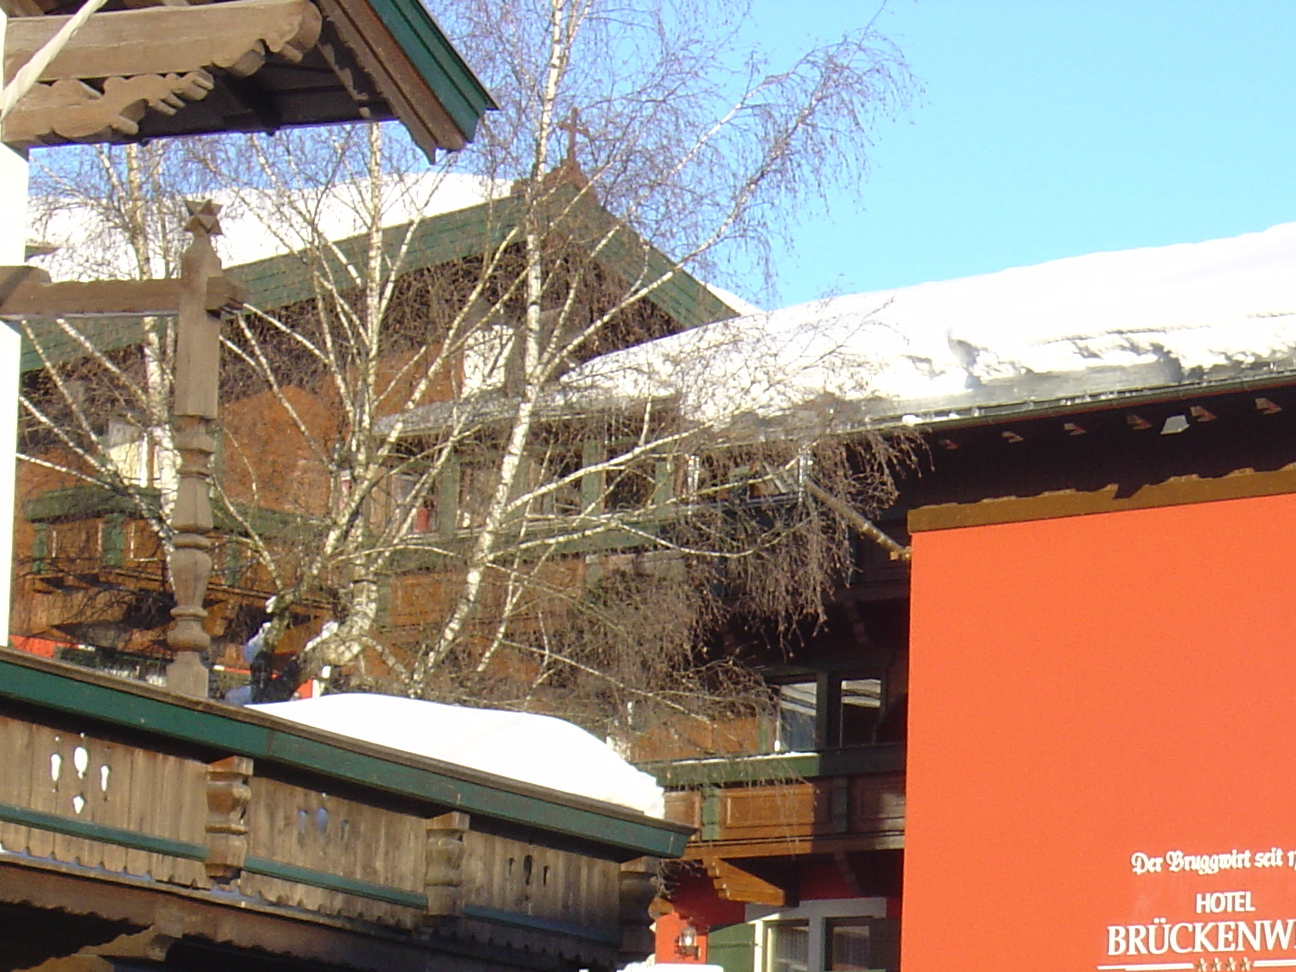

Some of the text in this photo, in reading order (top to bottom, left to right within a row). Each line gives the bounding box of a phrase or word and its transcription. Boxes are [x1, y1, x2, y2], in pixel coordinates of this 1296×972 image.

[1131, 853, 1163, 875] Der
[1255, 847, 1283, 868] seit
[1195, 891, 1256, 914] HOTEL
